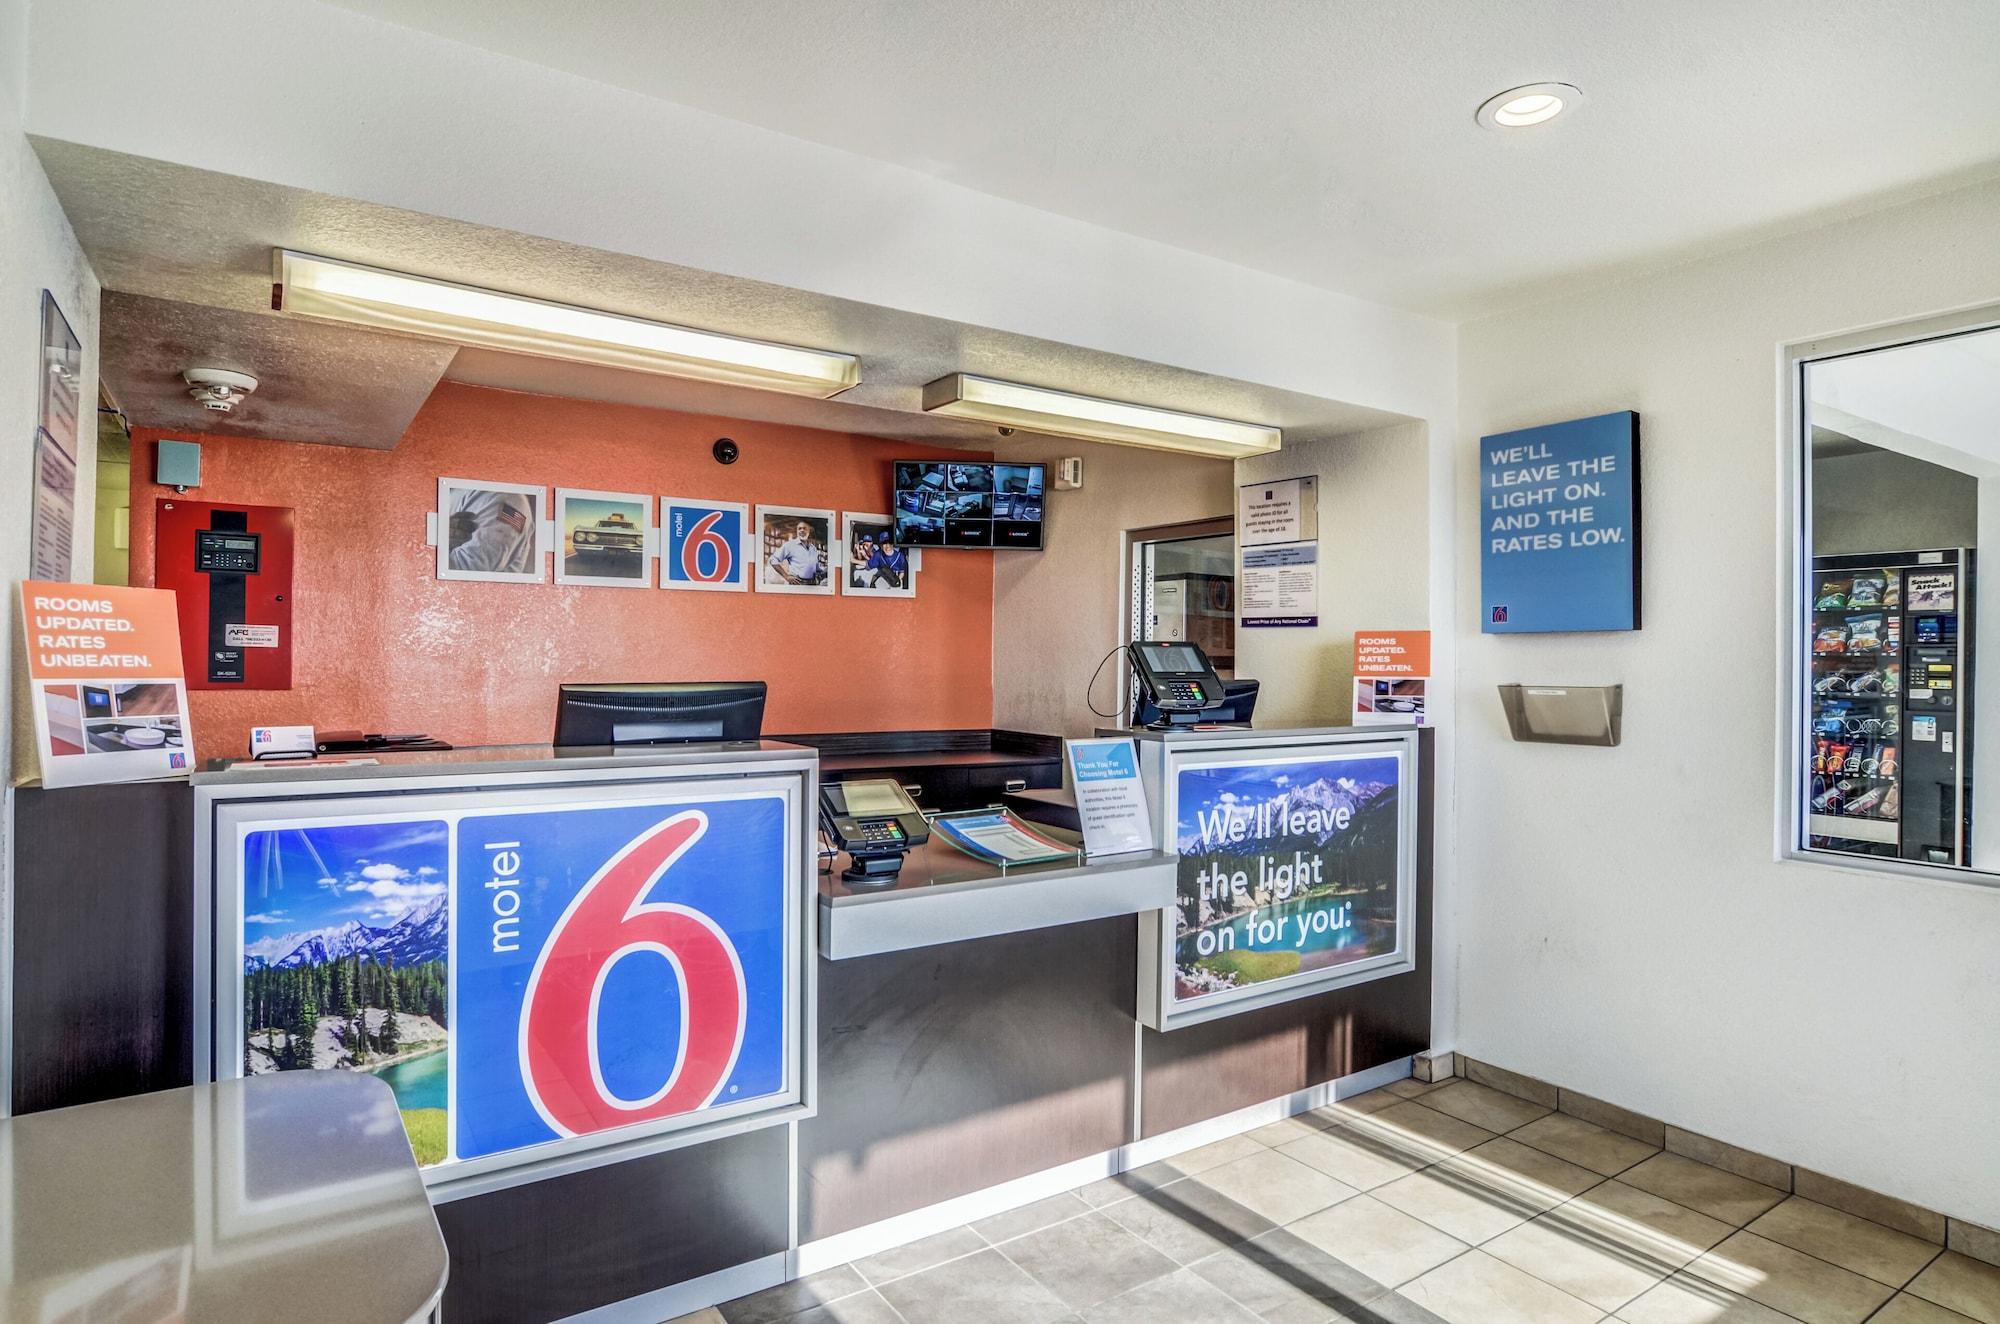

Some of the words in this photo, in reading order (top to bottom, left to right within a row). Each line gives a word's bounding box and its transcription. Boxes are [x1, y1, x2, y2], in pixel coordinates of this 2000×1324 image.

[1491, 444, 1552, 465] WE'LL
[1492, 464, 1560, 488] LEAVE
[1568, 456, 1615, 476] THE
[1492, 488, 1557, 510] LIGHT
[1564, 482, 1605, 501] ON.
[1491, 513, 1539, 532] AND
[1547, 507, 1593, 525] THE
[682, 511, 732, 583] 6
[1492, 533, 1562, 553] RATES
[1571, 528, 1625, 547] LOW.
[1916, 582, 1952, 590] Attack!
[35, 597, 112, 612] ROOMS
[36, 616, 135, 632] UPDATED.
[38, 635, 105, 649] RATES
[41, 654, 152, 667] UNBEATEN.
[1077, 761, 1096, 769] Thank
[1079, 770, 1108, 778] Choosing
[1198, 803, 1271, 845] We'll
[1283, 801, 1350, 836] leave
[1197, 862, 1248, 900] the
[1260, 851, 1323, 900] light
[1197, 926, 1235, 956] on
[1246, 910, 1288, 946] for
[485, 841, 520, 952] motel
[518, 809, 747, 1139] 6
